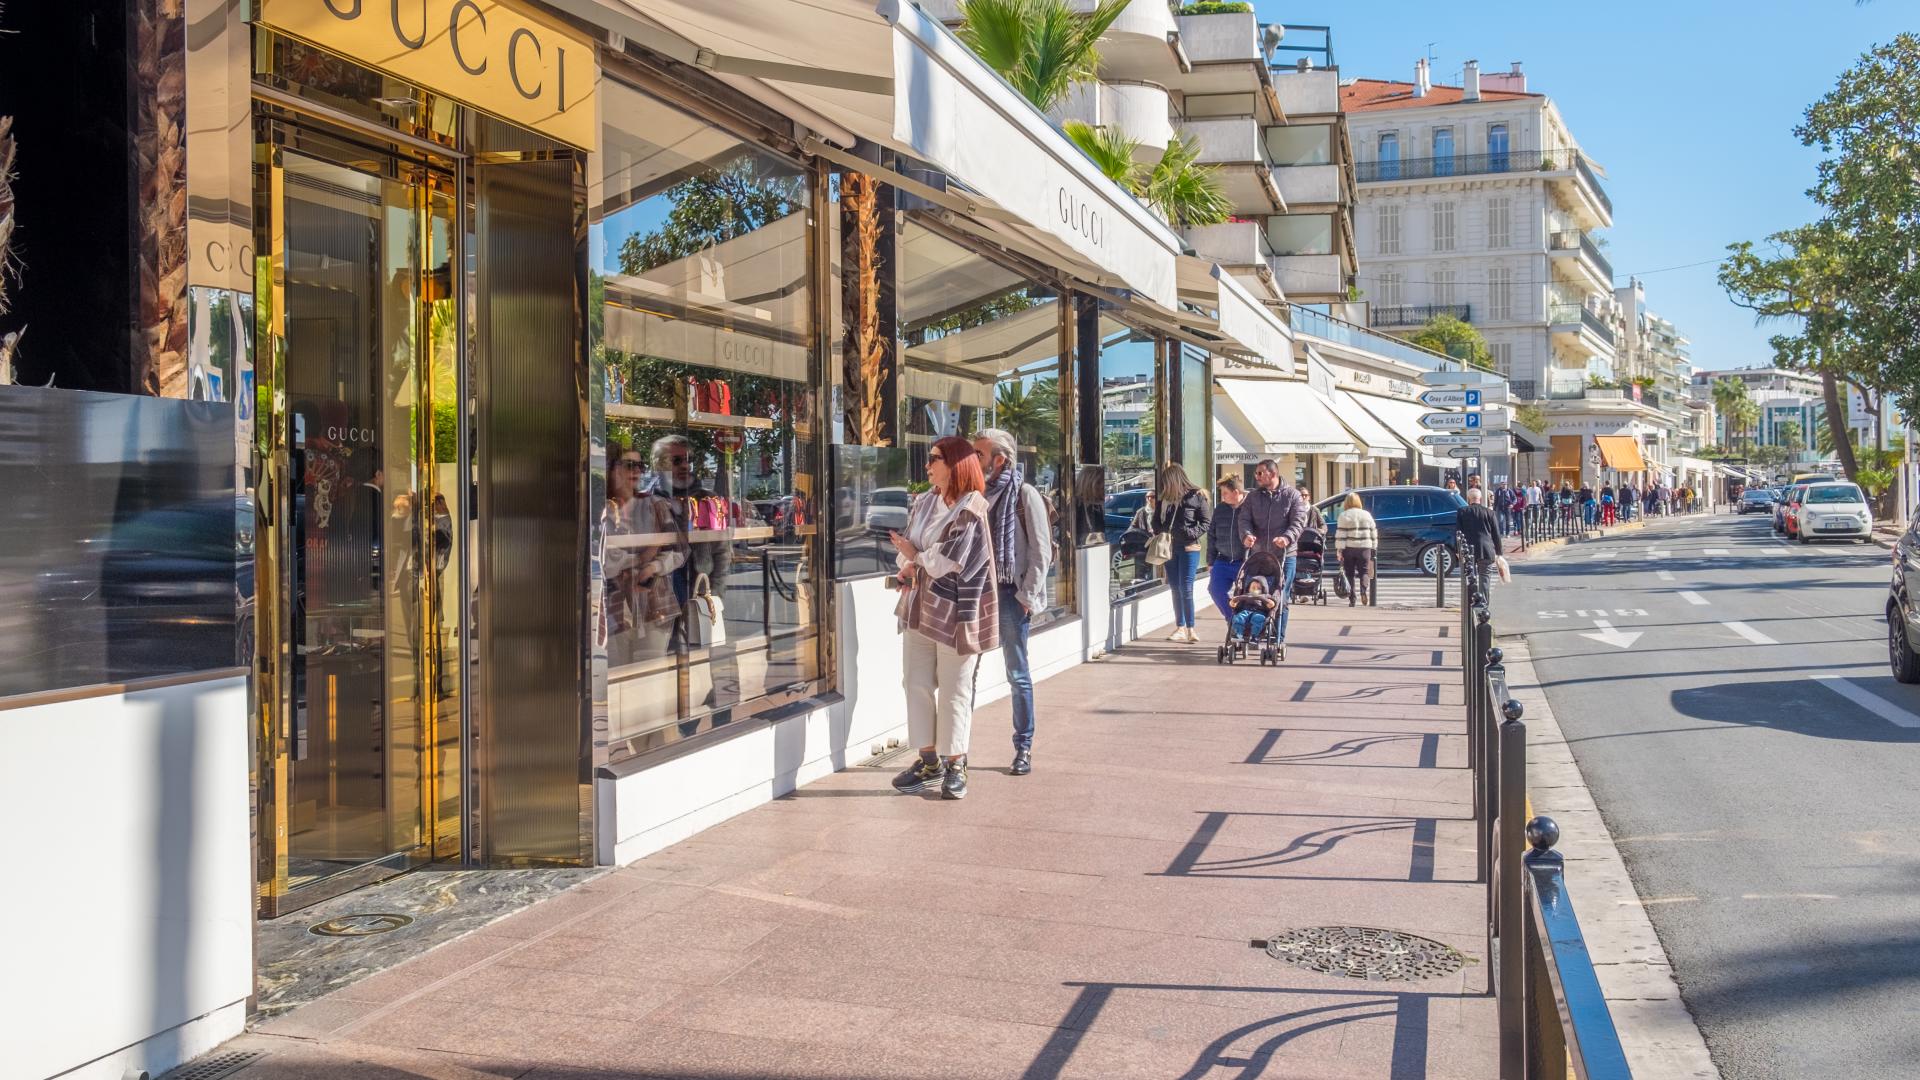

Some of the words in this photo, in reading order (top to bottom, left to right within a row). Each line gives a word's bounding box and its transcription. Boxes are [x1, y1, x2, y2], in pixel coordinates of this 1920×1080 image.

[323, 0, 566, 113] UCCI
[1059, 187, 1103, 249] GUCCI
[1429, 395, 1441, 403] Gray
[328, 426, 375, 443] GUCCI
